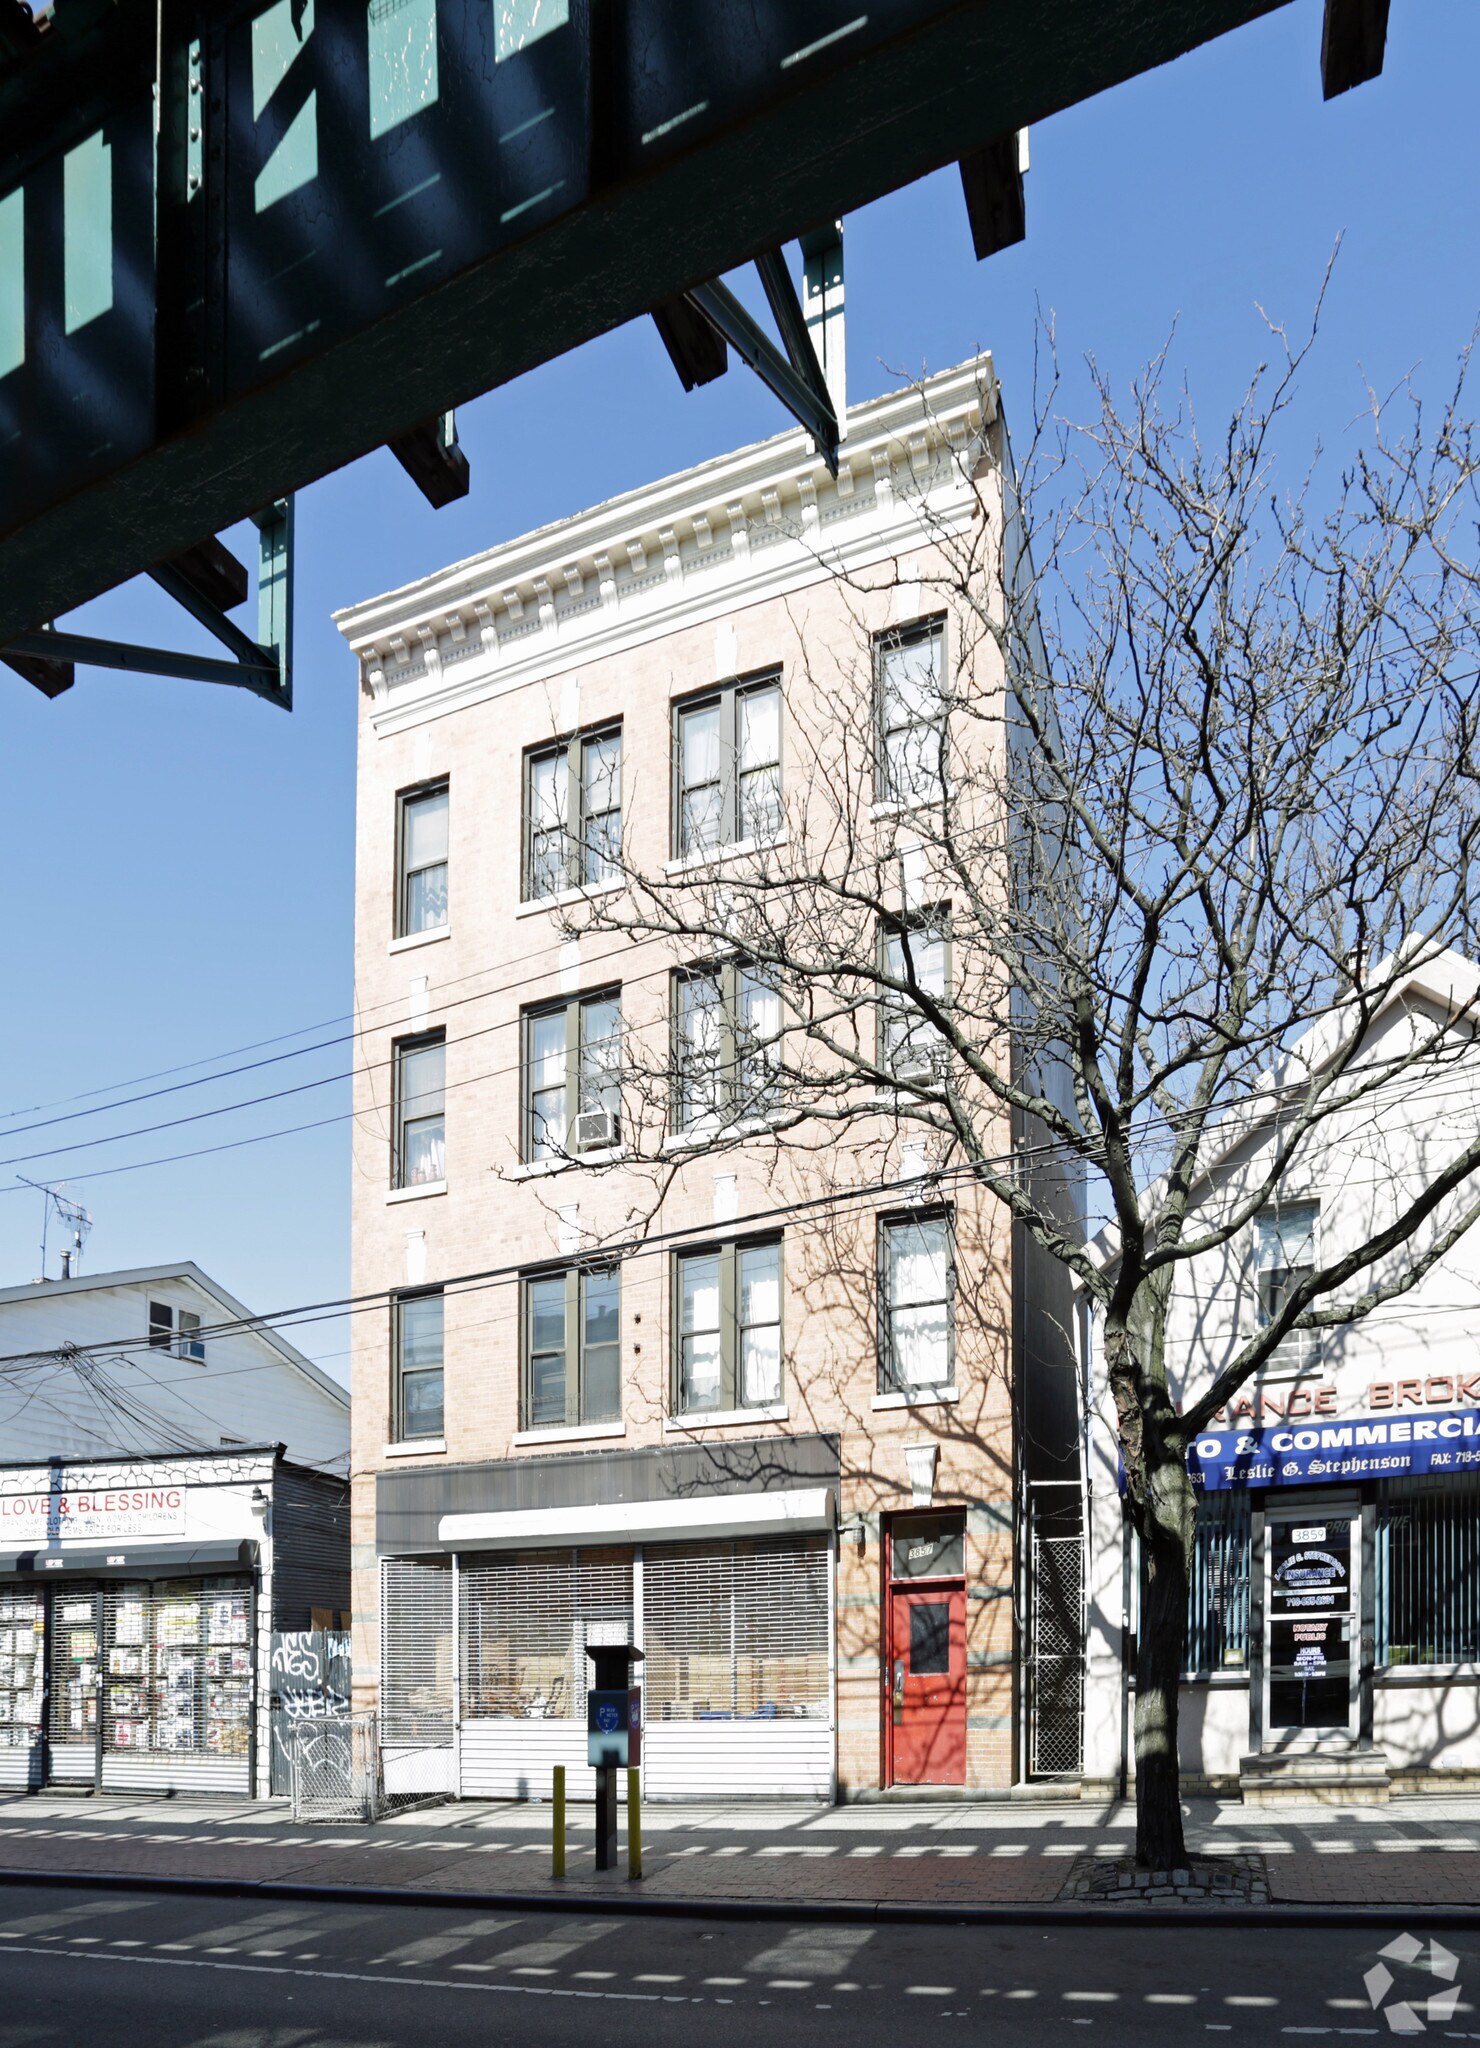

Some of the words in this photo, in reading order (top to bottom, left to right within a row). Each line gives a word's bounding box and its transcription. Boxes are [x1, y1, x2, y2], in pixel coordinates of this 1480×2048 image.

[1235, 1436, 1260, 1455] &
[1430, 1453, 1452, 1466] FAX:
[1224, 1464, 1275, 1482] Leslie
[1282, 1461, 1302, 1476] G.
[1307, 1454, 1411, 1475] Stephenson
[2, 1498, 51, 1516] LOVE
[58, 1497, 70, 1515] &
[78, 1491, 181, 1513] BLESSING
[84, 1524, 105, 1535] PRICE
[107, 1524, 121, 1534] FOR
[124, 1523, 142, 1533] LESS
[1293, 1529, 1326, 1541] 3859
[909, 1543, 933, 1559] 3857
[1285, 1567, 1337, 1580] INSURANCE
[1293, 1623, 1328, 1632] NOTARY
[1294, 1632, 1327, 1641] PUBLIC
[1300, 1646, 1321, 1654] HOURS
